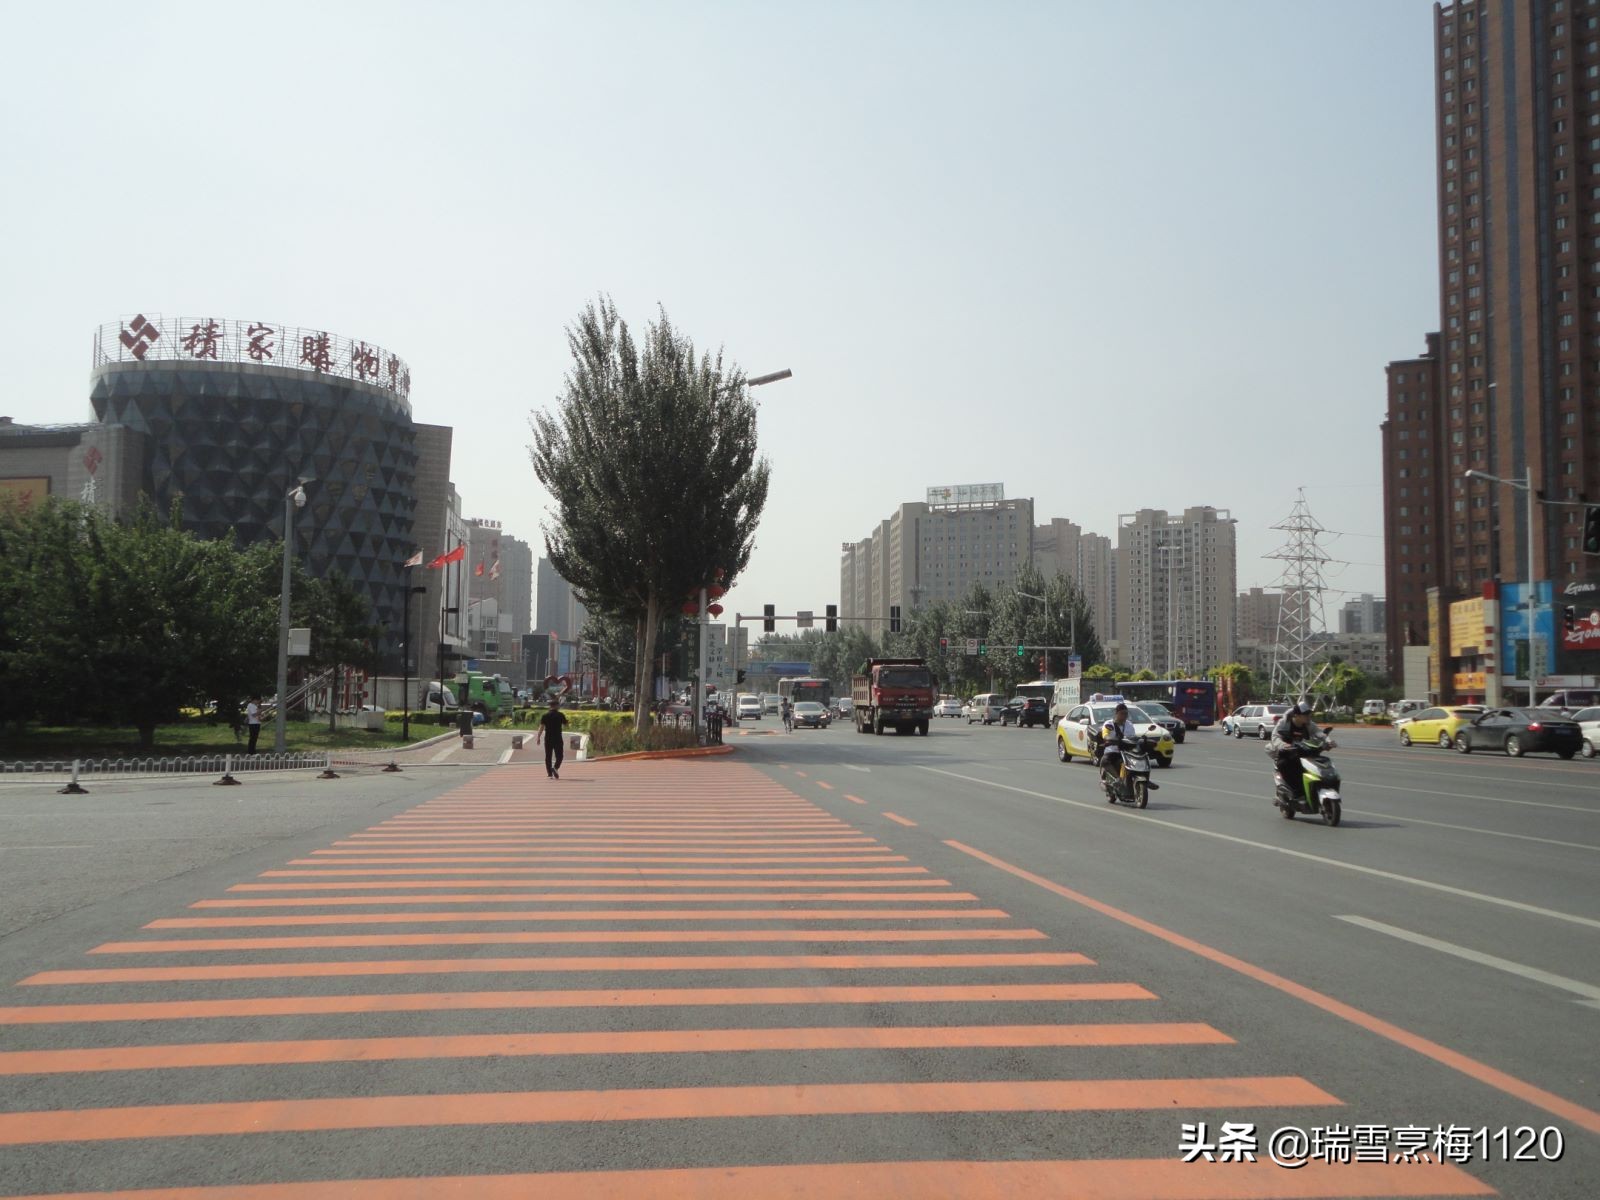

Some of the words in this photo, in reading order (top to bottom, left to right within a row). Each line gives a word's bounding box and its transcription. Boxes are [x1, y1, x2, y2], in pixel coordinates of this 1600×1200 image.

[180, 318, 411, 392] 積家購物中
